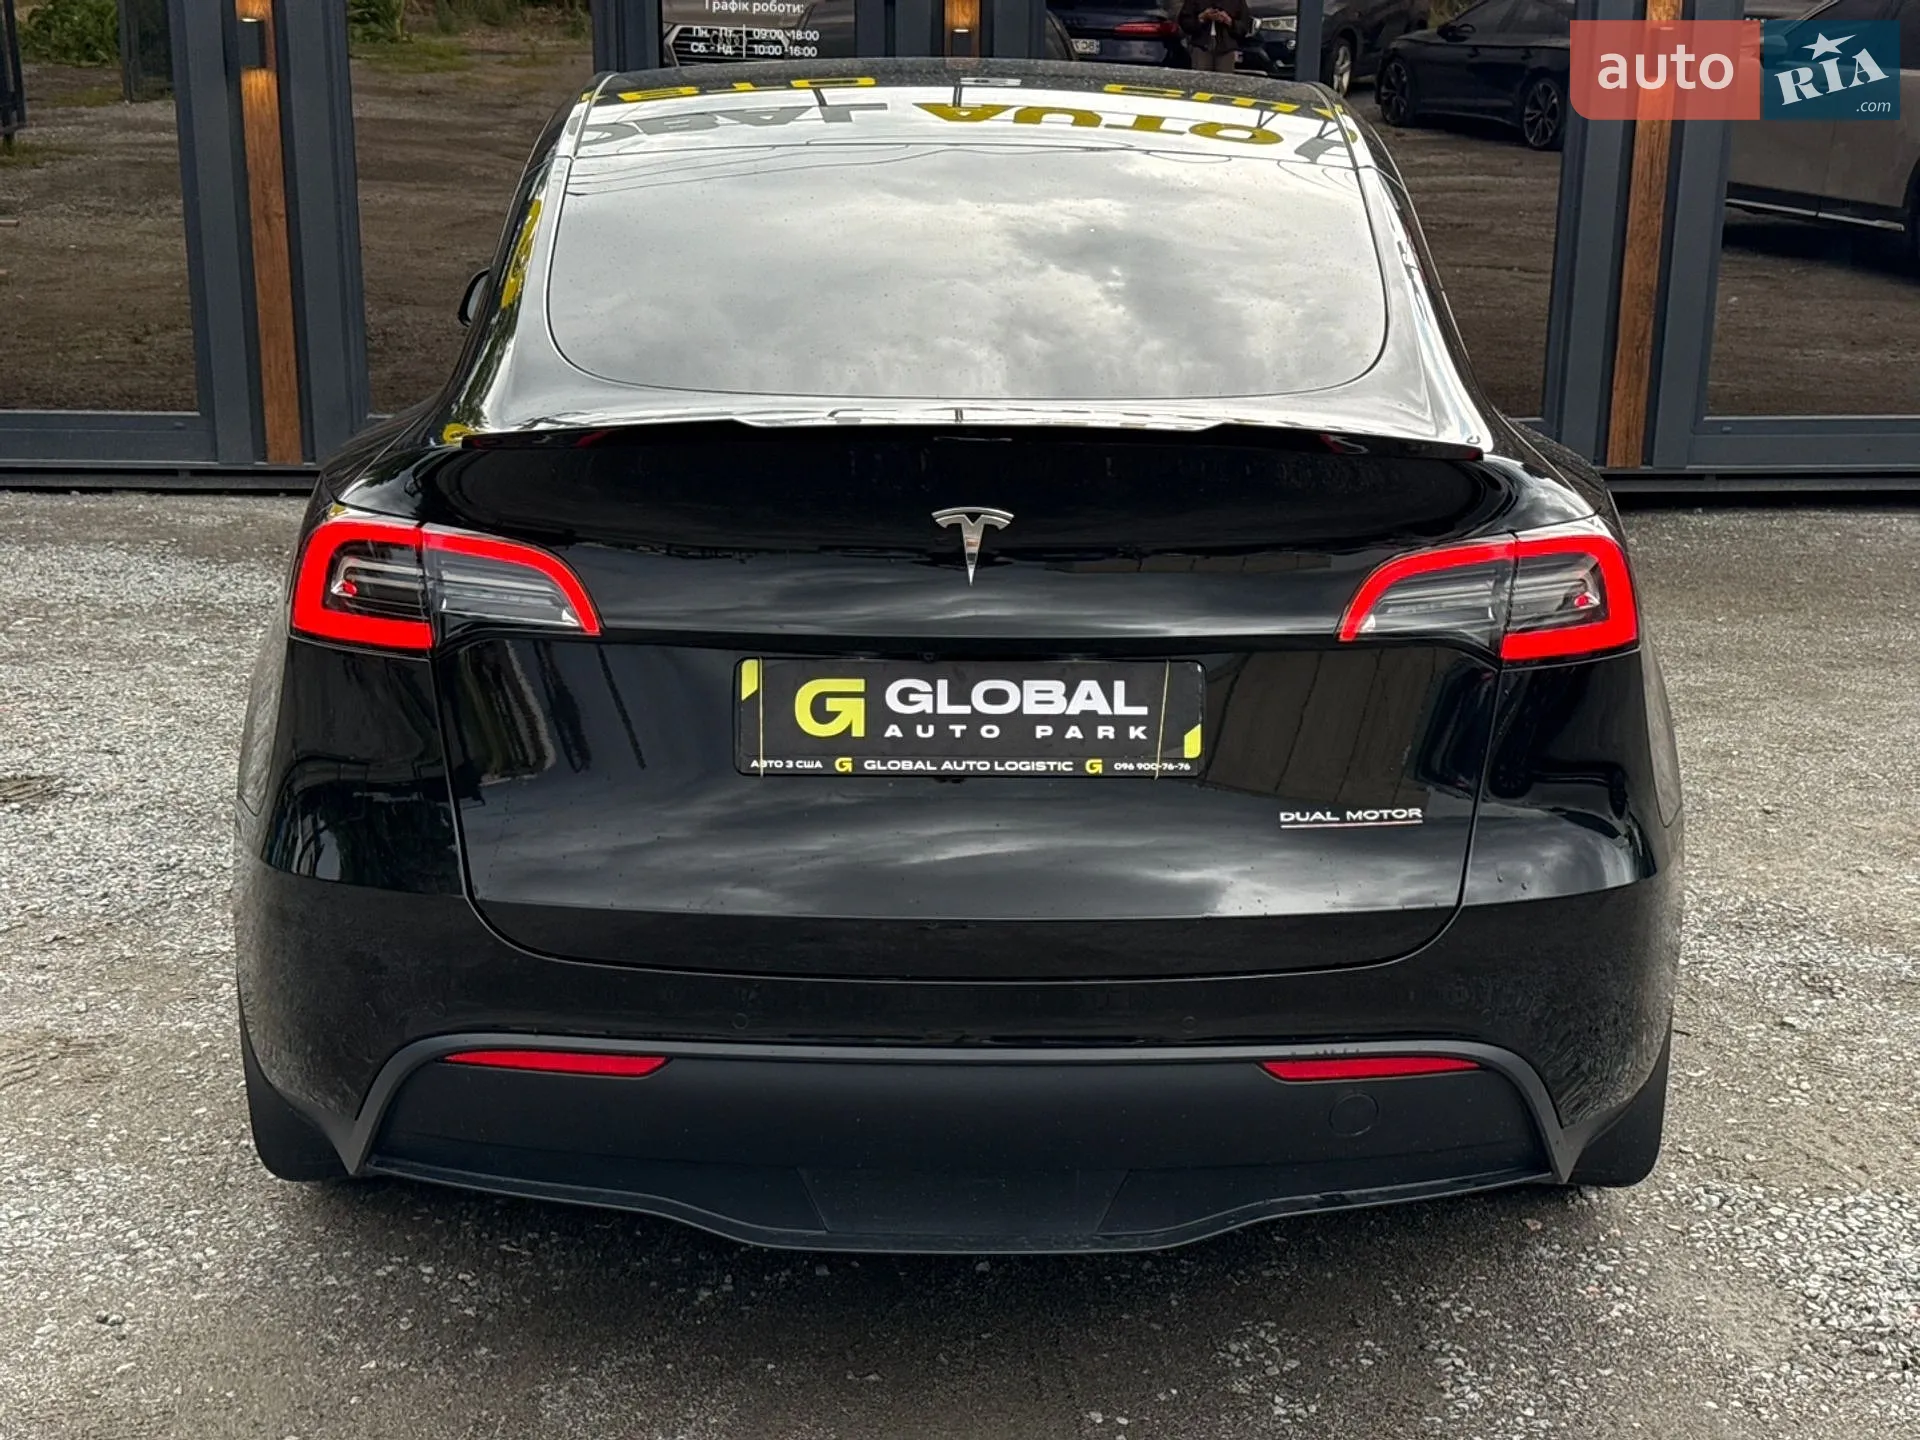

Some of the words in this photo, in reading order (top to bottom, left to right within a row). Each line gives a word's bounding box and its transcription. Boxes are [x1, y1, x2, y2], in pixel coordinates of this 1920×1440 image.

[885, 678, 1149, 716] GLOBAL
[884, 724, 1000, 739] AUTO
[1035, 725, 1148, 739] PARK
[750, 759, 782, 769] АВТО
[795, 759, 823, 769] США
[864, 760, 937, 771] GLOBAL
[941, 760, 991, 771] AUTO
[994, 761, 1074, 771] LOGISTIC
[1113, 761, 1135, 771] 096
[1279, 811, 1340, 822] DUAL
[1346, 808, 1423, 821] MOTOR
